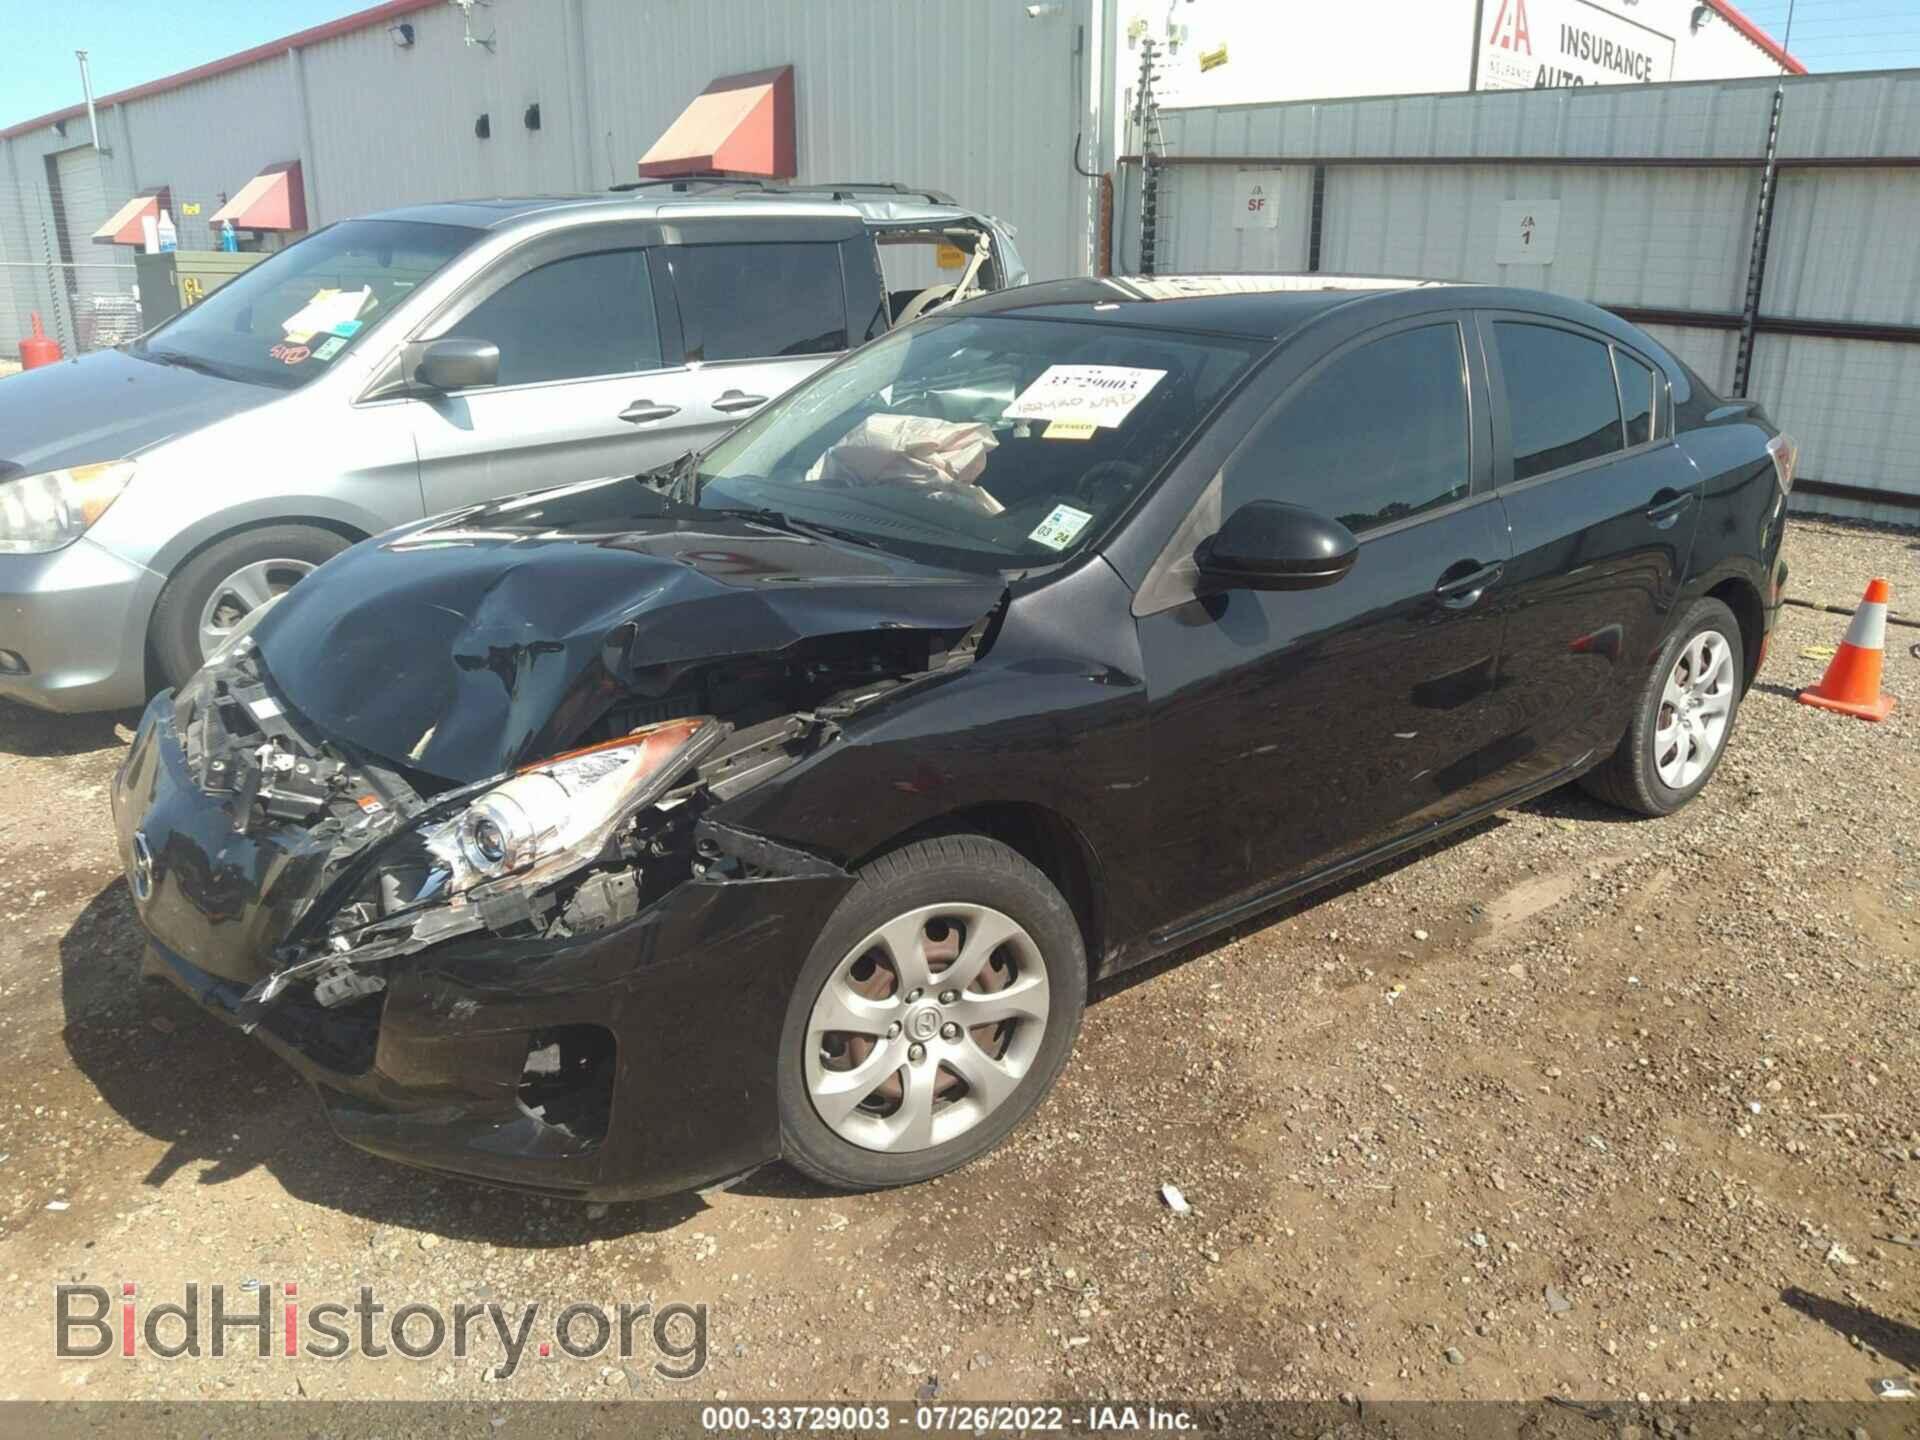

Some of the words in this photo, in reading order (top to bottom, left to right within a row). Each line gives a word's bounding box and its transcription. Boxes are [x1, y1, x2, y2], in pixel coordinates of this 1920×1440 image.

[1561, 23, 1653, 82] INSURANCE
[1248, 199, 1266, 211] SF
[1522, 230, 1531, 245] 1
[1037, 525, 1052, 537] 03
[1054, 531, 1070, 543] 24
